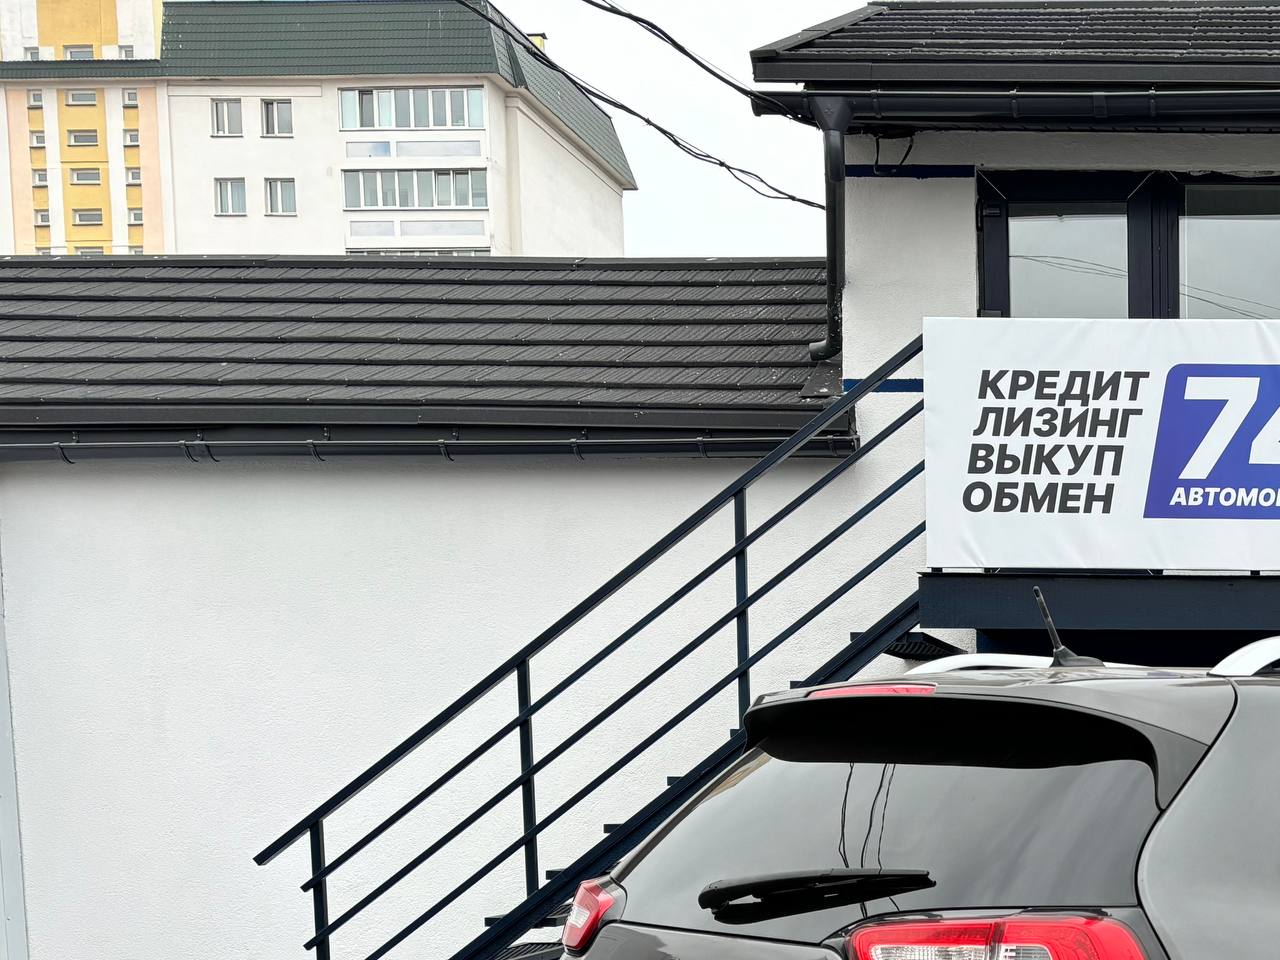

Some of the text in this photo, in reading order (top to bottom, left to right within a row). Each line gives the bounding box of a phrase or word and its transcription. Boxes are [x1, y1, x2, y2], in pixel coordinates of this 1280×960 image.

[978, 370, 1150, 406] КРЕДИТ
[972, 407, 1143, 438] ЛИЗИНГ
[967, 443, 1124, 476] ВЫКУП
[962, 481, 1115, 514] ОБМЕН
